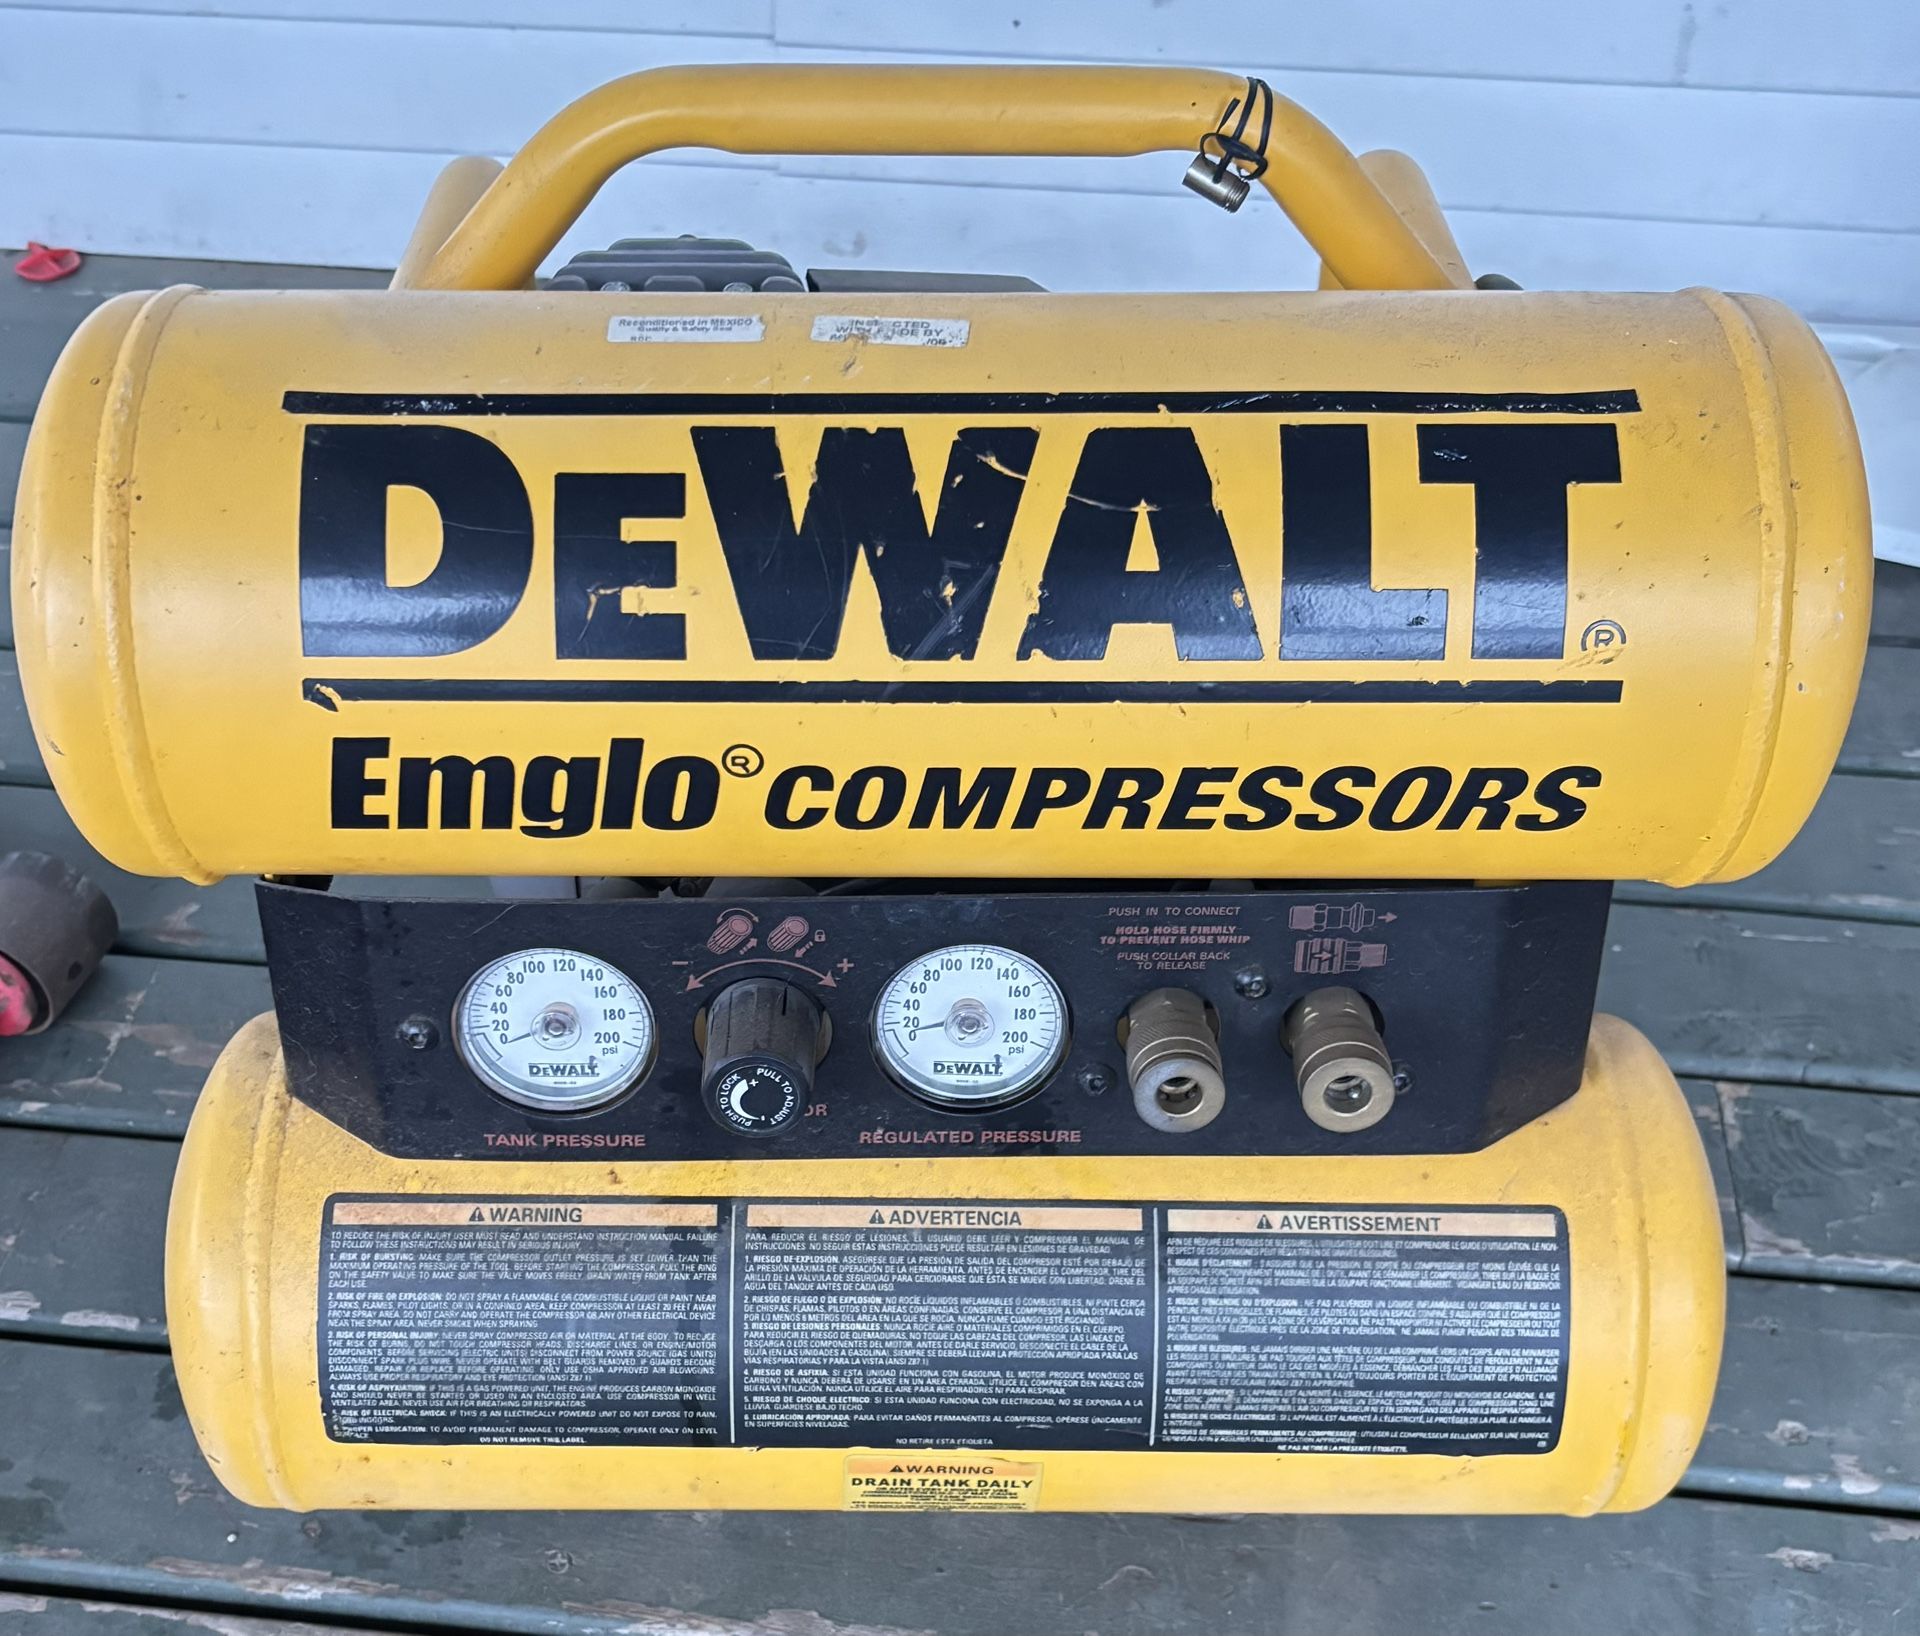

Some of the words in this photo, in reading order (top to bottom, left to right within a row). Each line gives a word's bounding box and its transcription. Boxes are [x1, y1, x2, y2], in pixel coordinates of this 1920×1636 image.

[710, 318, 753, 326] MEXICO
[923, 329, 944, 338] BY
[763, 765, 1602, 831] COMPRESSORS
[1108, 907, 1142, 916] PUSH
[1145, 907, 1159, 916] IN
[1164, 907, 1177, 916] TO
[1180, 906, 1241, 916] CONNECT
[1115, 926, 1150, 935] HOLD
[1153, 926, 1186, 935] HOSE
[1189, 926, 1236, 935] FIRMLY
[1100, 936, 1117, 945] TO
[1119, 936, 1177, 945] PREVENT
[1180, 936, 1214, 944] HOSE
[1217, 935, 1250, 944] WHIP
[1117, 952, 1149, 961] PUSH
[1151, 952, 1196, 961] COLLAR
[1199, 952, 1231, 961] BACK
[523, 961, 545, 973] 100
[553, 959, 576, 971] 120
[940, 959, 962, 971] 100
[970, 958, 993, 970] 120
[1137, 961, 1152, 970] TO
[1156, 961, 1206, 970] RELEASE
[507, 972, 524, 984] 80
[580, 969, 603, 981] 140
[923, 970, 940, 982] 80
[996, 968, 1019, 980] 140
[495, 985, 512, 997] 60
[594, 986, 617, 998] 160
[910, 982, 927, 994] 60
[1008, 985, 1030, 998] 160
[490, 1002, 508, 1014] 40
[903, 999, 920, 1011] 40
[603, 1008, 626, 1021] 180
[1014, 1009, 1036, 1020] 180
[492, 1020, 510, 1032] 20
[903, 1017, 920, 1028] 20
[500, 1034, 508, 1045] 0
[594, 1032, 621, 1044] 200
[908, 1030, 917, 1042] 0
[1002, 1032, 1028, 1043] 200
[602, 1046, 618, 1057] psi
[1008, 1045, 1024, 1056] psi
[757, 1067, 781, 1083] PULL
[720, 1073, 741, 1096] LOCK
[781, 1081, 793, 1094] TO
[720, 1097, 728, 1111] TO
[769, 1094, 795, 1125] ADJUST
[725, 1110, 753, 1127] PUSH
[484, 1134, 537, 1147] TANK
[543, 1134, 646, 1147] PRESSURE
[859, 1131, 974, 1144] REGULATED
[980, 1130, 1082, 1143] PRESSURE
[490, 1207, 583, 1223] WARNING
[889, 1210, 1022, 1226] ADVERTENCIA
[1279, 1215, 1441, 1233] AVERTISSEMENT
[744, 1282, 766, 1291] AGUA
[768, 1283, 782, 1291] DEL
[783, 1283, 814, 1291] TANQUE
[816, 1283, 841, 1291] ANTES
[843, 1283, 854, 1291] DE
[855, 1283, 876, 1291] CADA
[907, 1465, 994, 1475] WARNING
[851, 1477, 912, 1487] DRAIN
[918, 1478, 969, 1488] TANK
[977, 1479, 1034, 1489] DAILY
